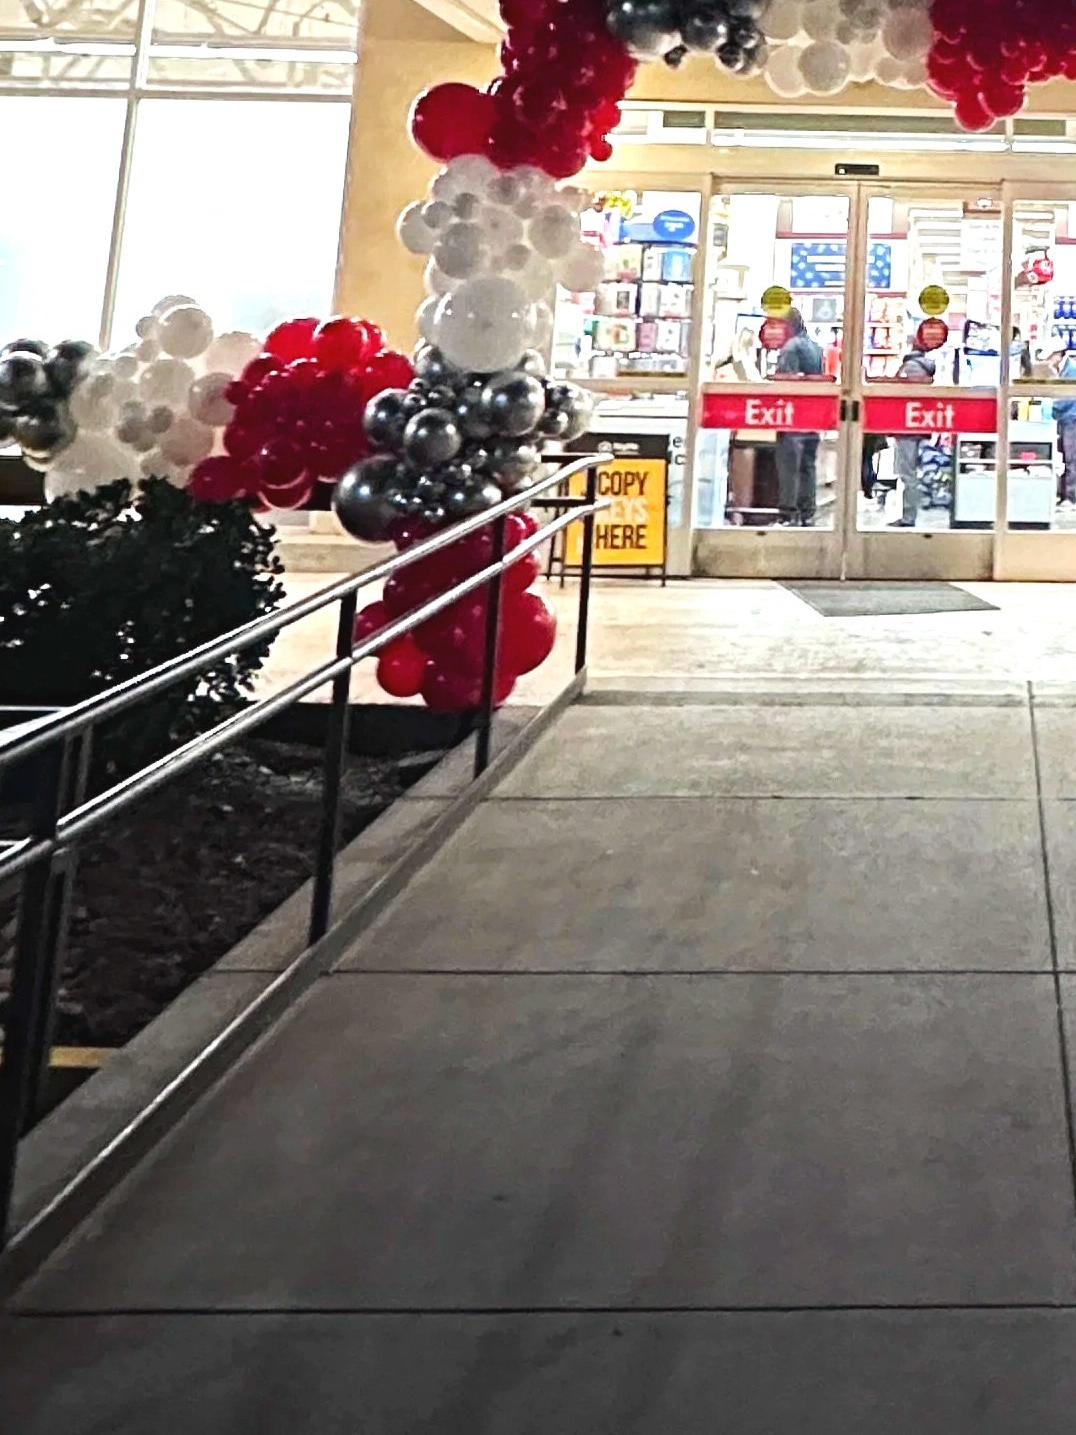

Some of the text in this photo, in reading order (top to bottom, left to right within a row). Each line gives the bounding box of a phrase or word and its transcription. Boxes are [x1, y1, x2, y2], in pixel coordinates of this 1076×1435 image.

[745, 399, 795, 426] Exit
[905, 401, 955, 428] Exit
[597, 470, 649, 496] COPY
[595, 523, 648, 550] HERE
